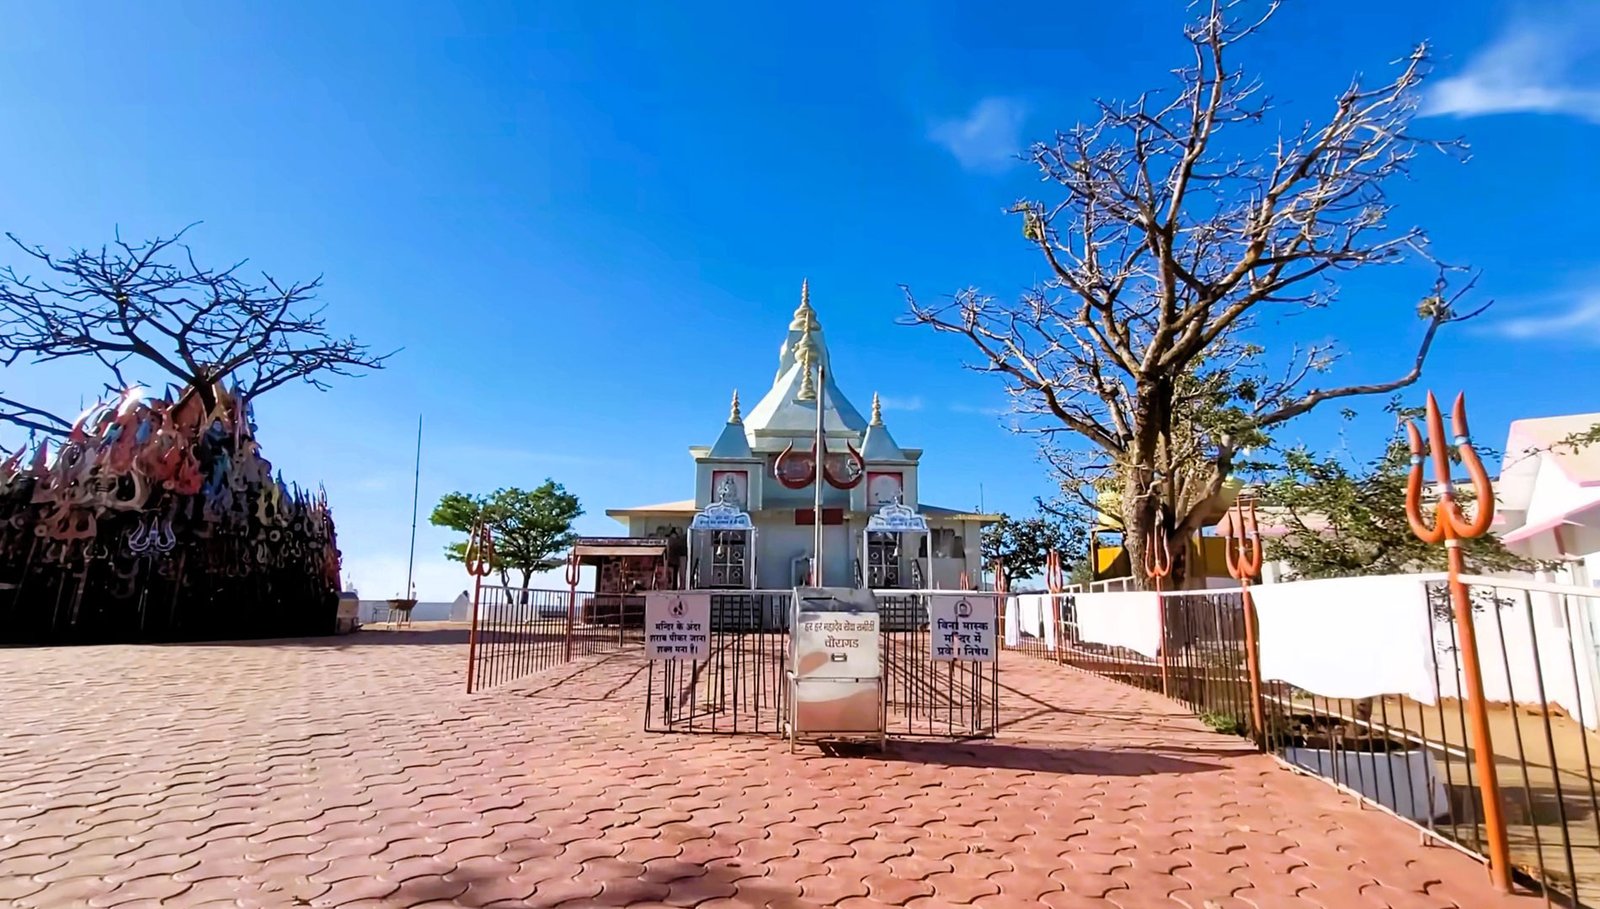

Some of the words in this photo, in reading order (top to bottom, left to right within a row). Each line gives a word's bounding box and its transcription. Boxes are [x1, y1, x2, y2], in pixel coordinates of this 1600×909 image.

[655, 620, 674, 631] मन्दिर
[676, 620, 684, 630] के
[686, 620, 701, 631] अंदर
[804, 622, 813, 632] हर
[814, 622, 823, 632] हर
[823, 619, 842, 632] महादेव
[937, 617, 959, 630] बिना
[962, 622, 989, 630] मास्क
[649, 634, 667, 642] शराब
[669, 631, 687, 642] पीकर
[689, 634, 706, 642] जाना
[973, 631, 982, 643] में
[674, 645, 688, 653] मना
[963, 644, 989, 655] निषेध
